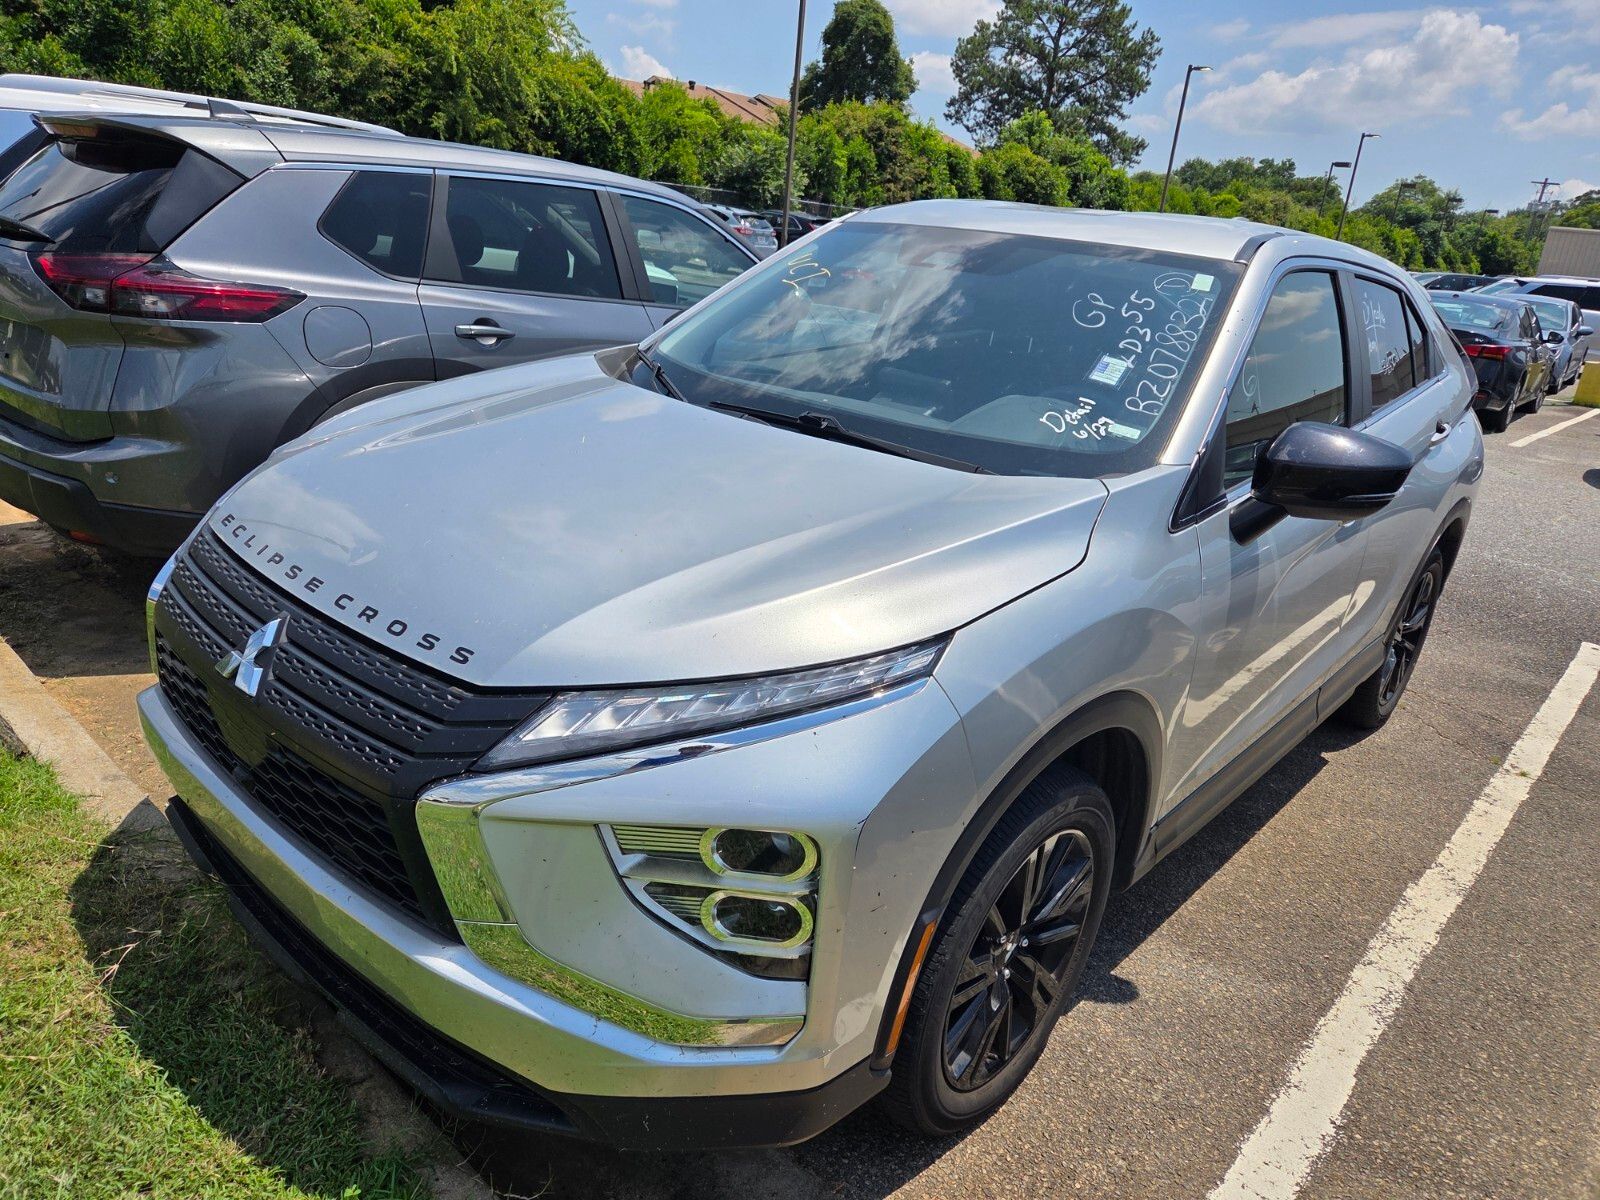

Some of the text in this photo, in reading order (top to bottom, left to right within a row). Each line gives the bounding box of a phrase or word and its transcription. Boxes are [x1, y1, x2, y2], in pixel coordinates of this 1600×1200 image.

[1039, 396, 1097, 433] Detail
[220, 513, 475, 665] ECLIPSE CROSS
